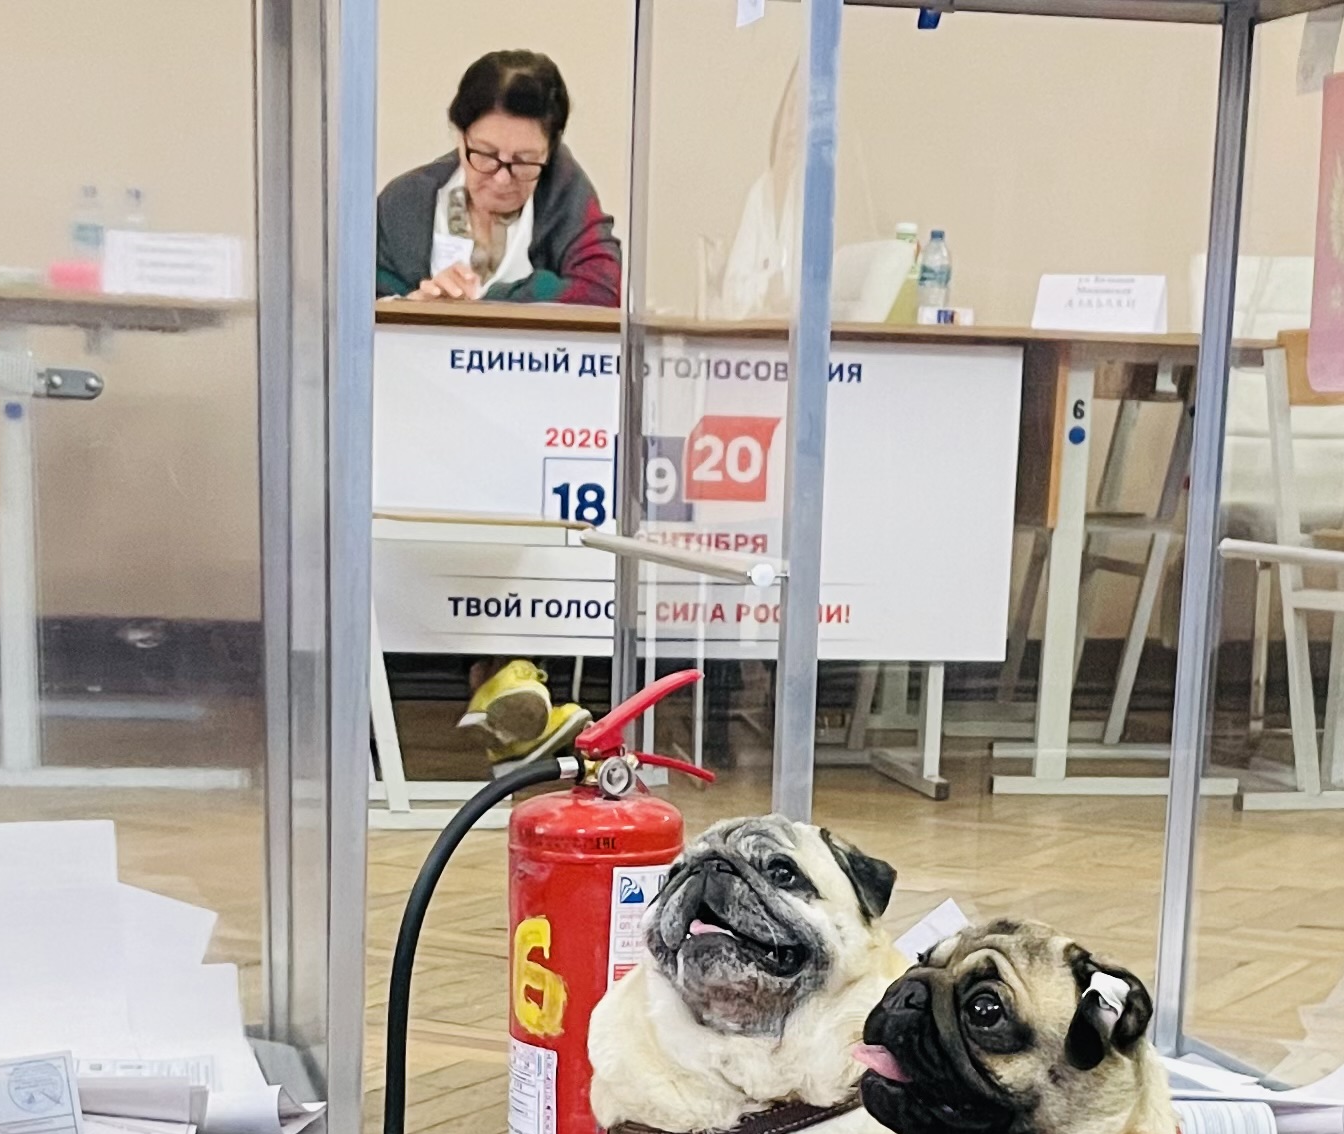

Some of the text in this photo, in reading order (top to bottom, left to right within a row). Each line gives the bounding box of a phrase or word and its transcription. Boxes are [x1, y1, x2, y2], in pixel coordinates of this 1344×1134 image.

[451, 347, 862, 383] ЕДИНЫЙ ДЕ ГОЛОСОВИЯ
[1073, 399, 1085, 420] 6
[545, 427, 608, 448] 2026
[692, 434, 763, 483] 20
[641, 456, 677, 504] 9
[552, 482, 606, 527] 18
[447, 592, 522, 618] ТВОЙ
[531, 598, 616, 619] ГОЛОС
[655, 602, 726, 623] СИЛА
[735, 603, 851, 624] РОСИ!
[513, 915, 568, 1037] 6
